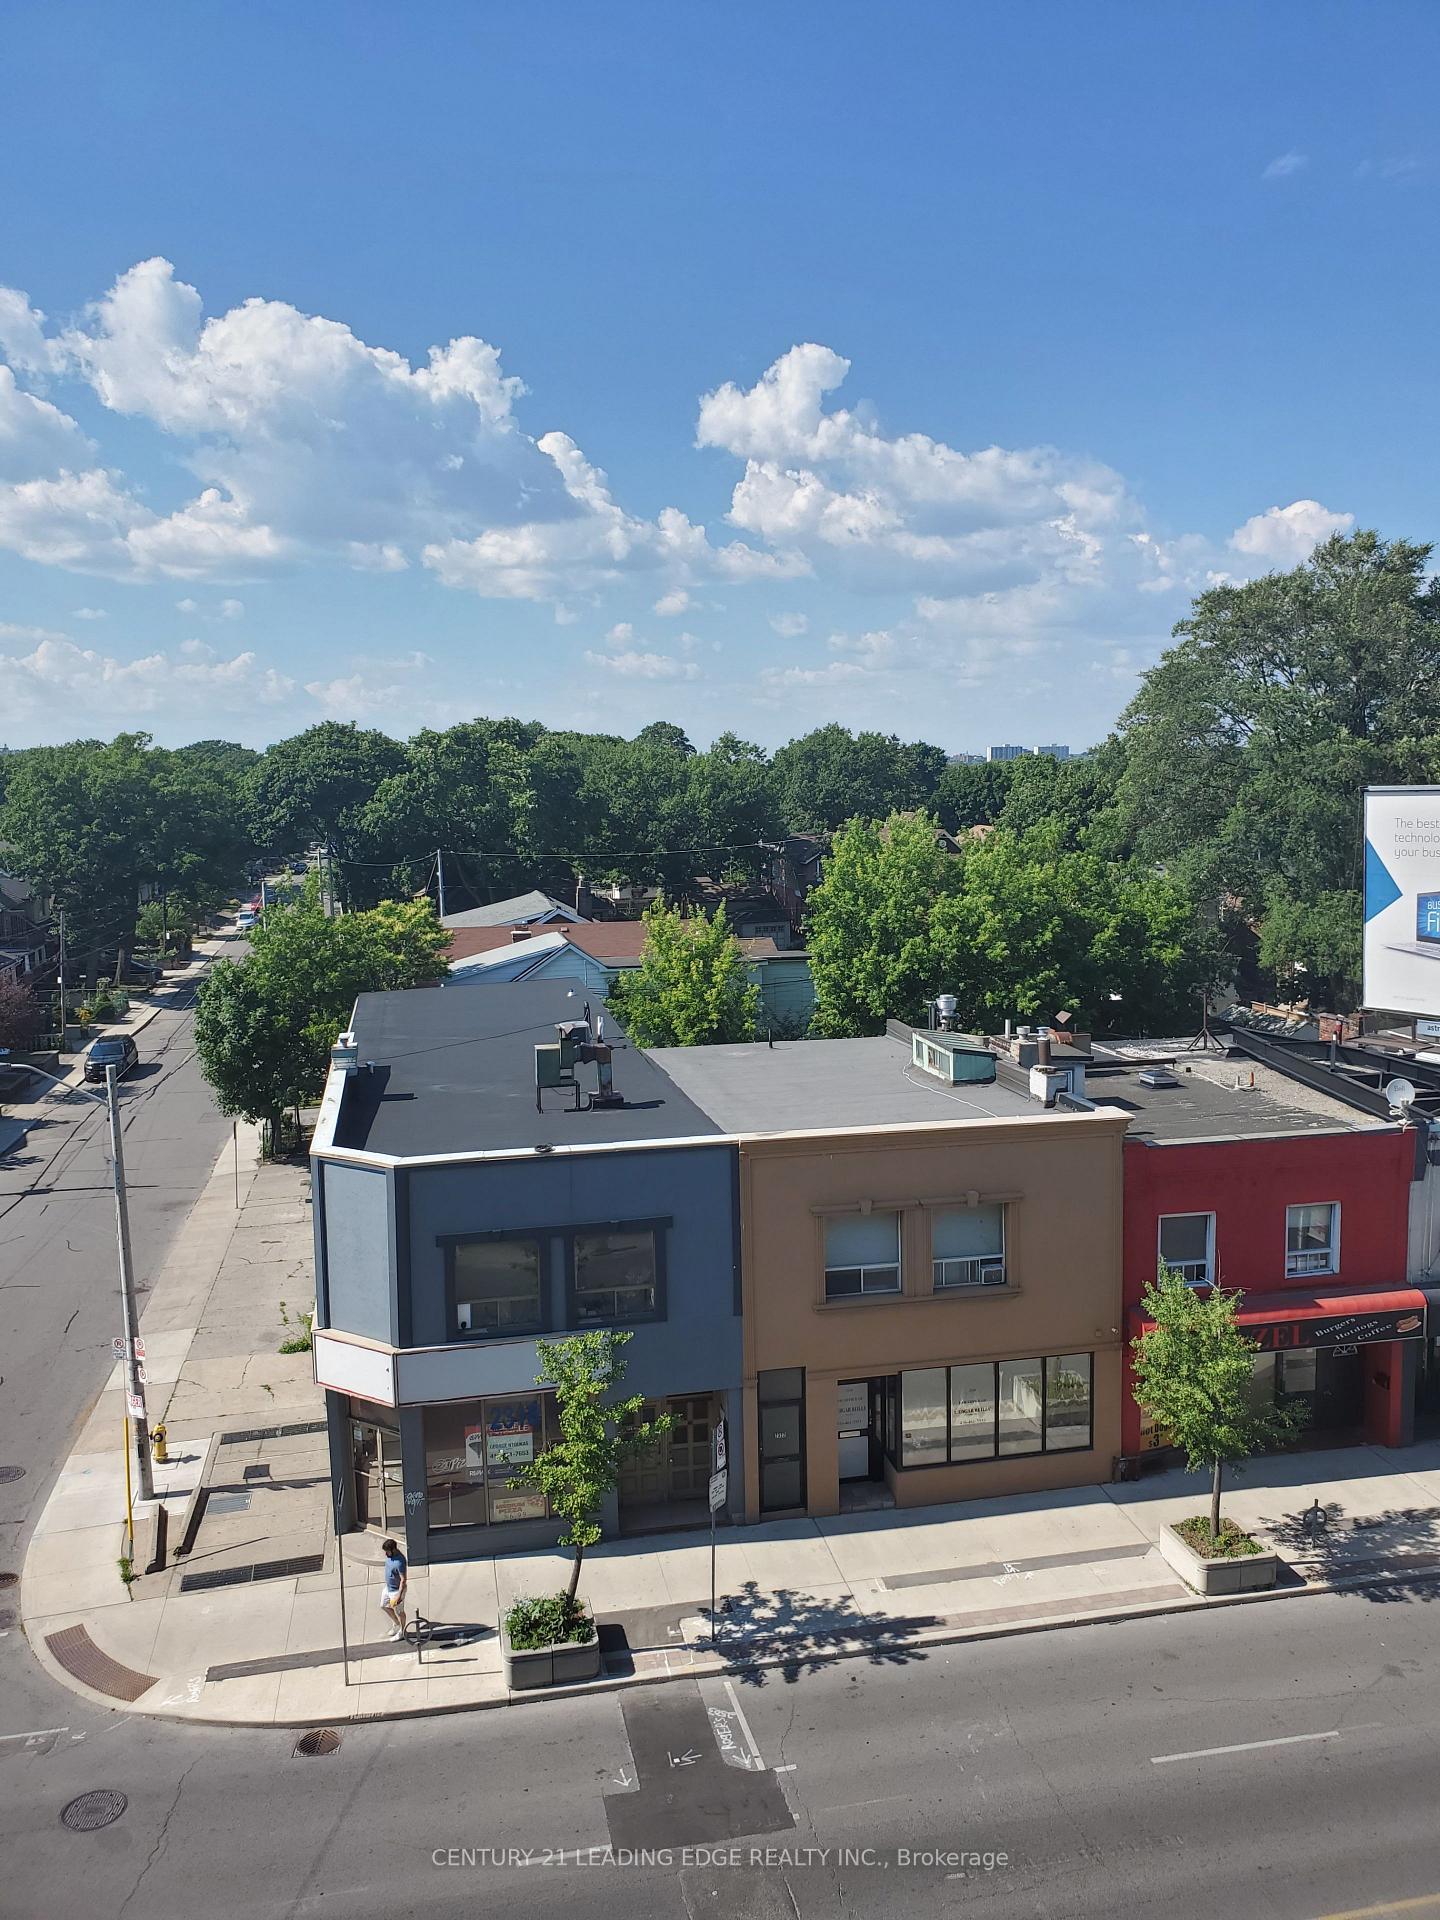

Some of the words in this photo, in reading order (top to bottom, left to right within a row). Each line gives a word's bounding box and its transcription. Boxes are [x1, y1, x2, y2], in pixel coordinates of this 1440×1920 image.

[1394, 817, 1413, 828] The
[1416, 817, 1440, 829] best
[1394, 832, 1440, 843] technolo
[1394, 848, 1420, 860] your
[1422, 847, 1440, 858] bus
[1314, 1317, 1356, 1337] Burgers
[1334, 1320, 1379, 1341] Hotdogs
[1357, 1323, 1392, 1341] Coffee
